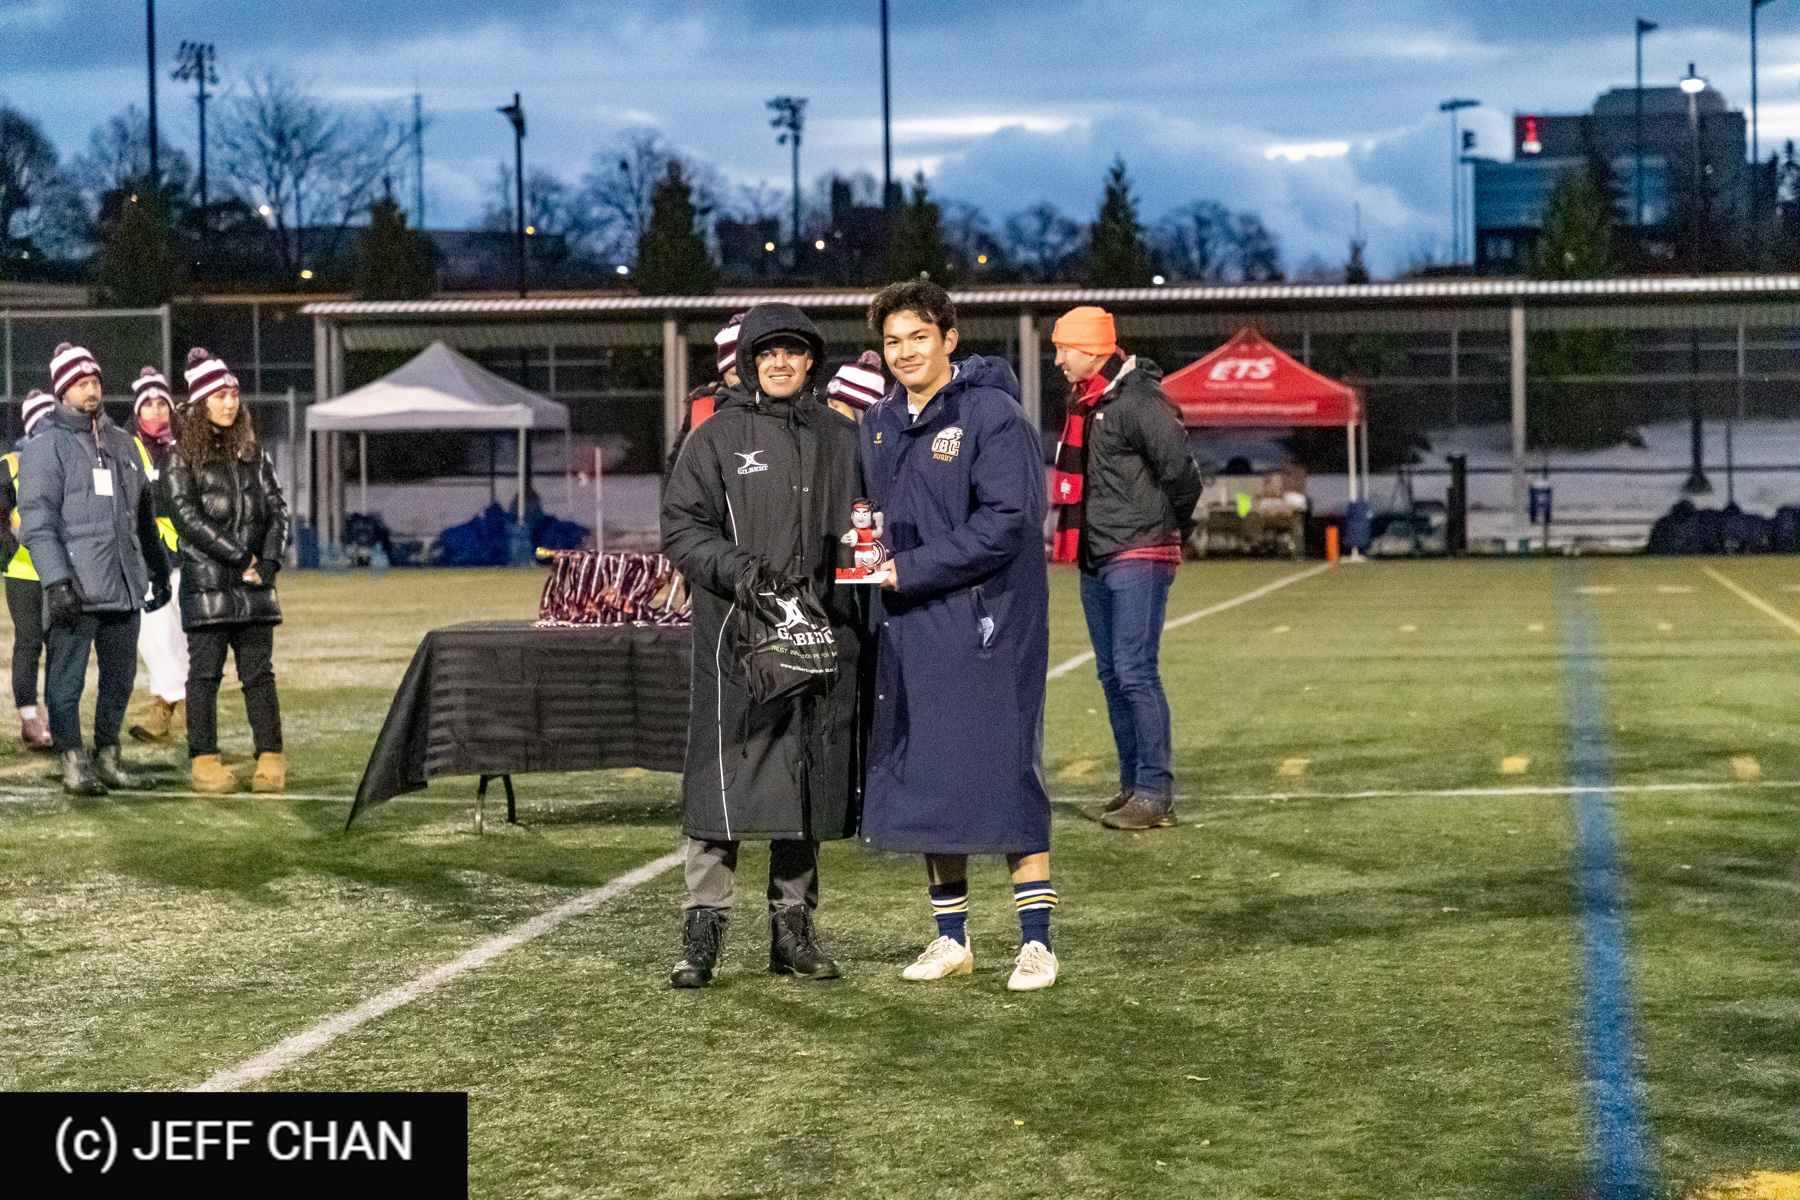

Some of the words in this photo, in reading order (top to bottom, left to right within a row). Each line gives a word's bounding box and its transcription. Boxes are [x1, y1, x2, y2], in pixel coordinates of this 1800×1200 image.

[1208, 356, 1277, 381] ETS
[931, 437, 961, 457] UBC
[932, 453, 954, 462] RUGBY
[737, 465, 769, 475] GILBERT
[835, 567, 868, 580] MVP
